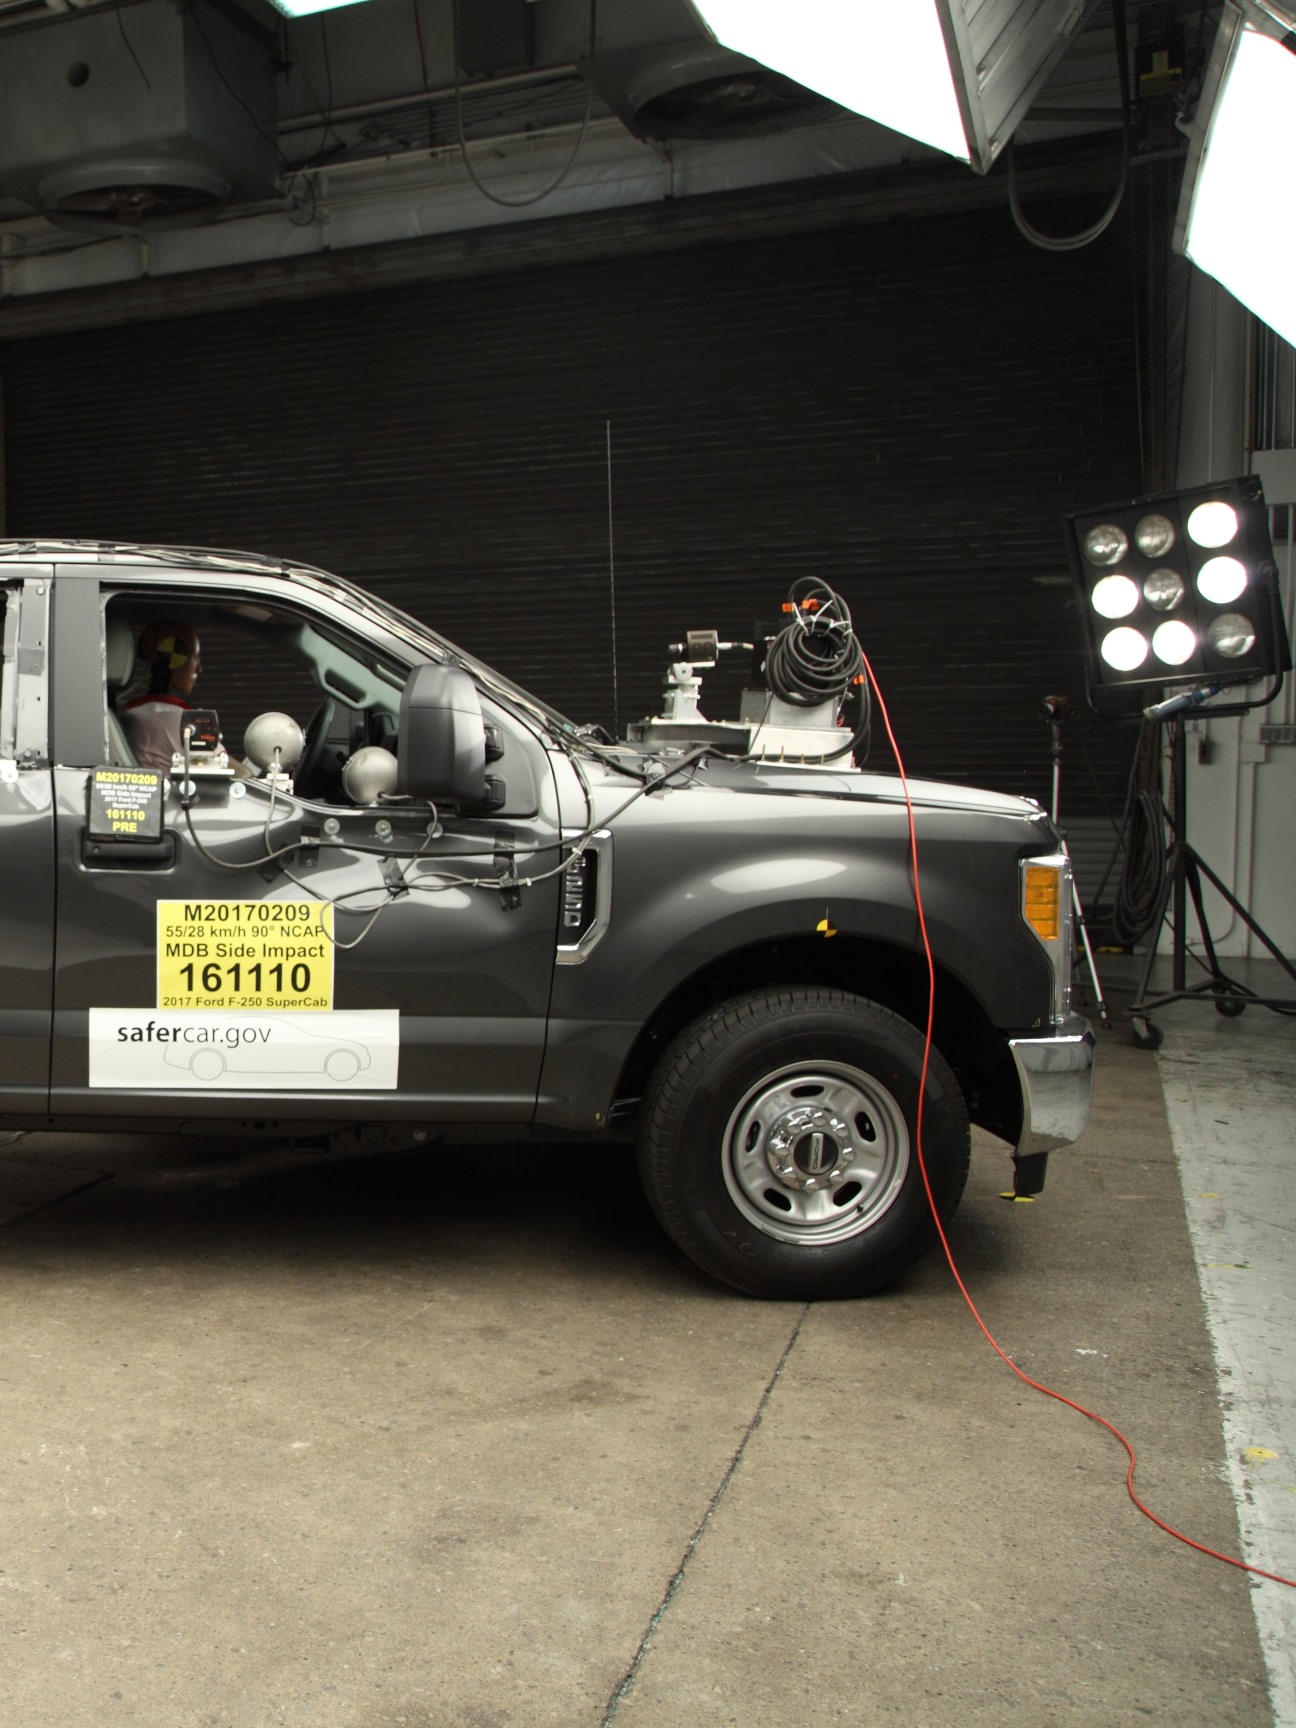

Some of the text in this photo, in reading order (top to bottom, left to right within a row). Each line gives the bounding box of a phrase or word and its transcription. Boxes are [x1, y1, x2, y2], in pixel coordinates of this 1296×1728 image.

[96, 771, 158, 785] M20170209
[106, 809, 145, 821] 161110
[113, 821, 137, 832] PRE
[184, 904, 310, 922] M20170209
[166, 925, 325, 938] 55/28 km/h 90° NCAP
[166, 943, 325, 961] MDB Side Impact
[179, 962, 311, 993] 161110
[163, 997, 328, 1008] 2017 Ford F-250 SuperCab
[117, 1020, 271, 1049] safercar.gov
